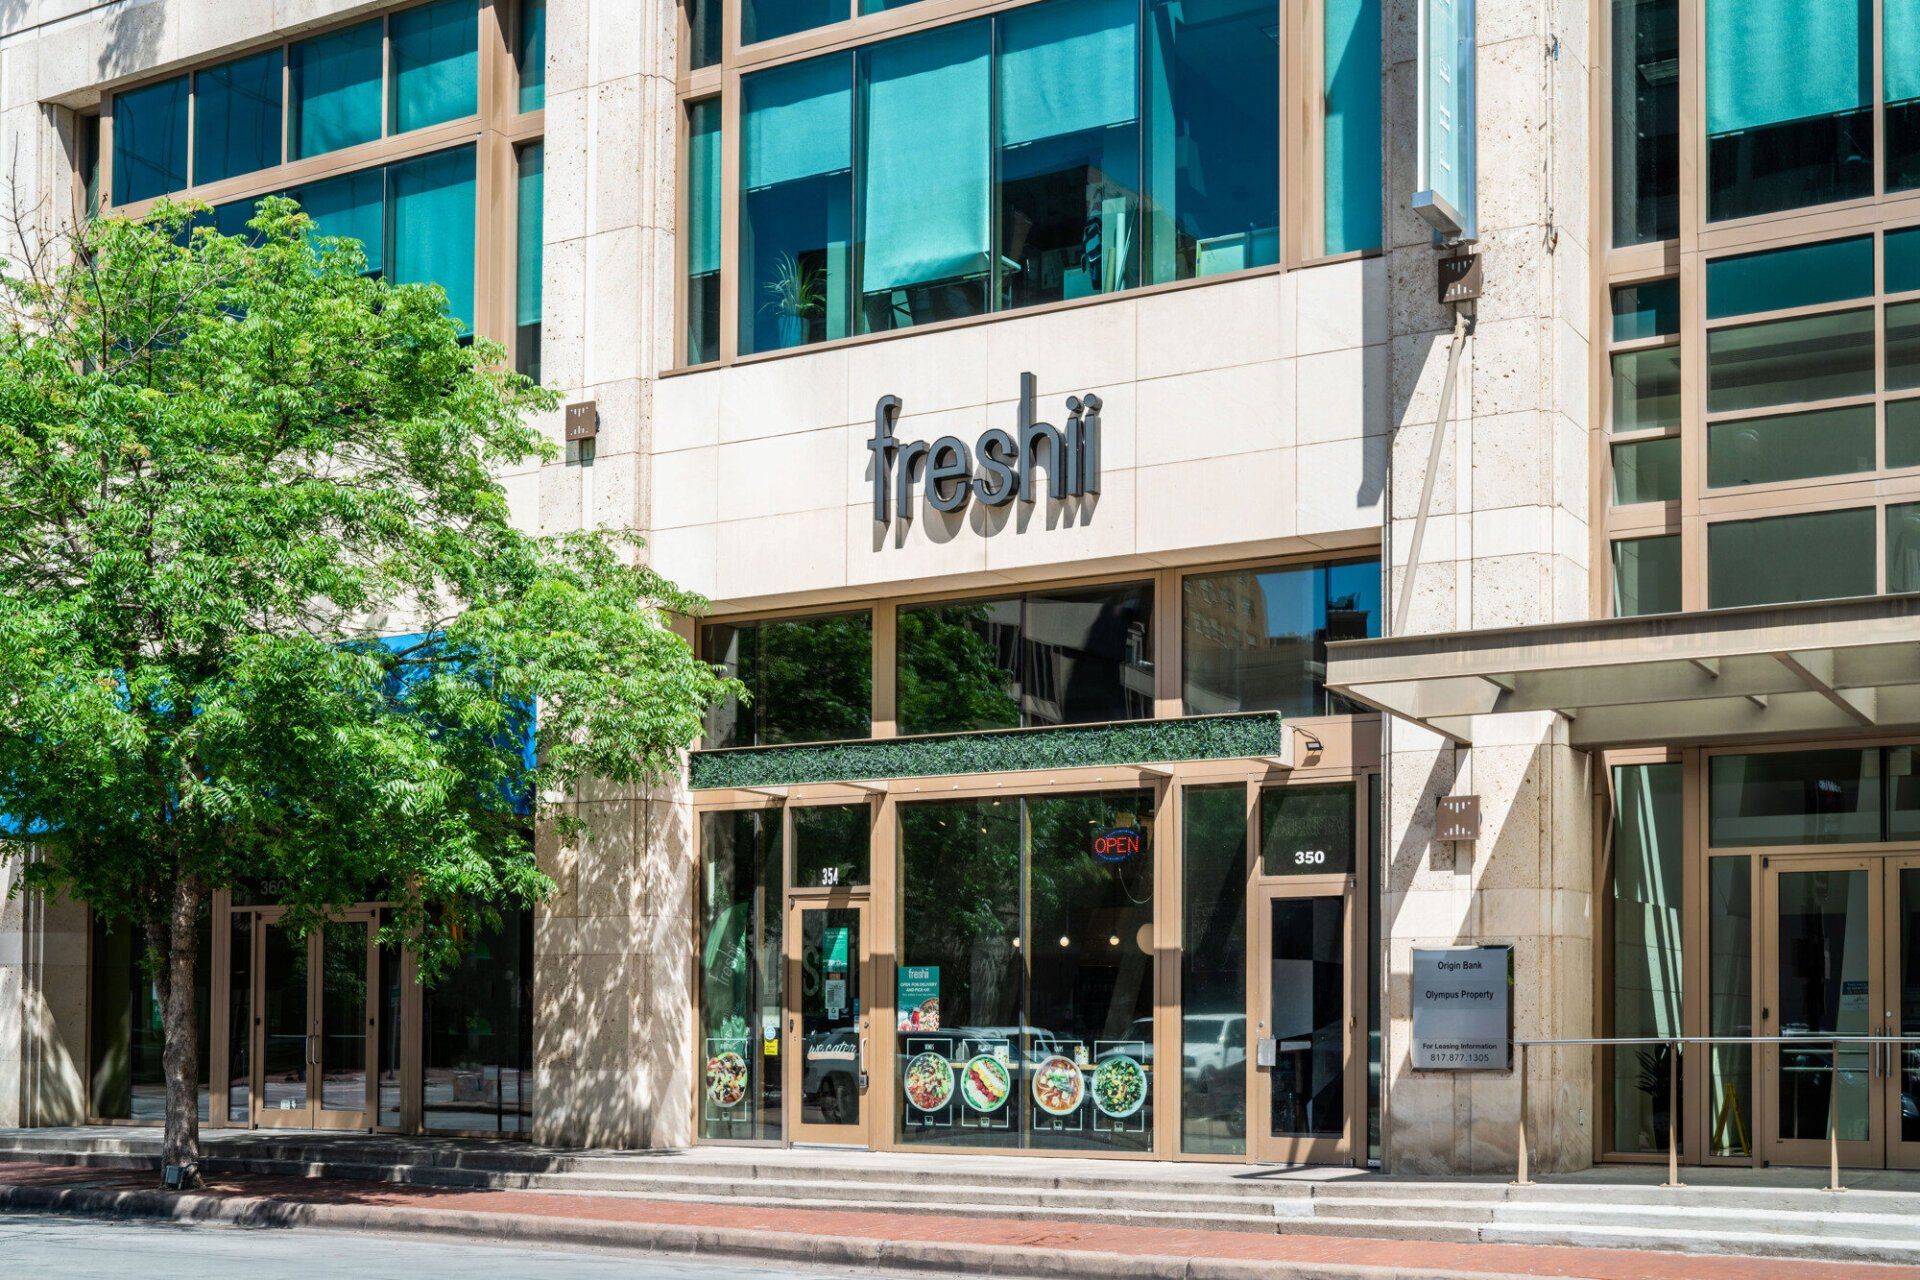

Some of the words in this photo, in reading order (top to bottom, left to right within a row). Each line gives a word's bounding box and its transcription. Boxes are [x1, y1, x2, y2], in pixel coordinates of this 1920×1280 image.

[867, 371, 1102, 523] freshii
[1095, 836, 1139, 854] OPEN
[1294, 850, 1325, 865] 350
[822, 867, 839, 885] 354
[1437, 961, 1461, 971] Origin
[1463, 961, 1482, 969] Bank
[1425, 990, 1459, 1001] Olympus
[1461, 990, 1494, 1000] Property
[1434, 1043, 1460, 1051] Leasing
[1460, 1042, 1498, 1050] Information
[1430, 1053, 1490, 1062] 817.877.1305
